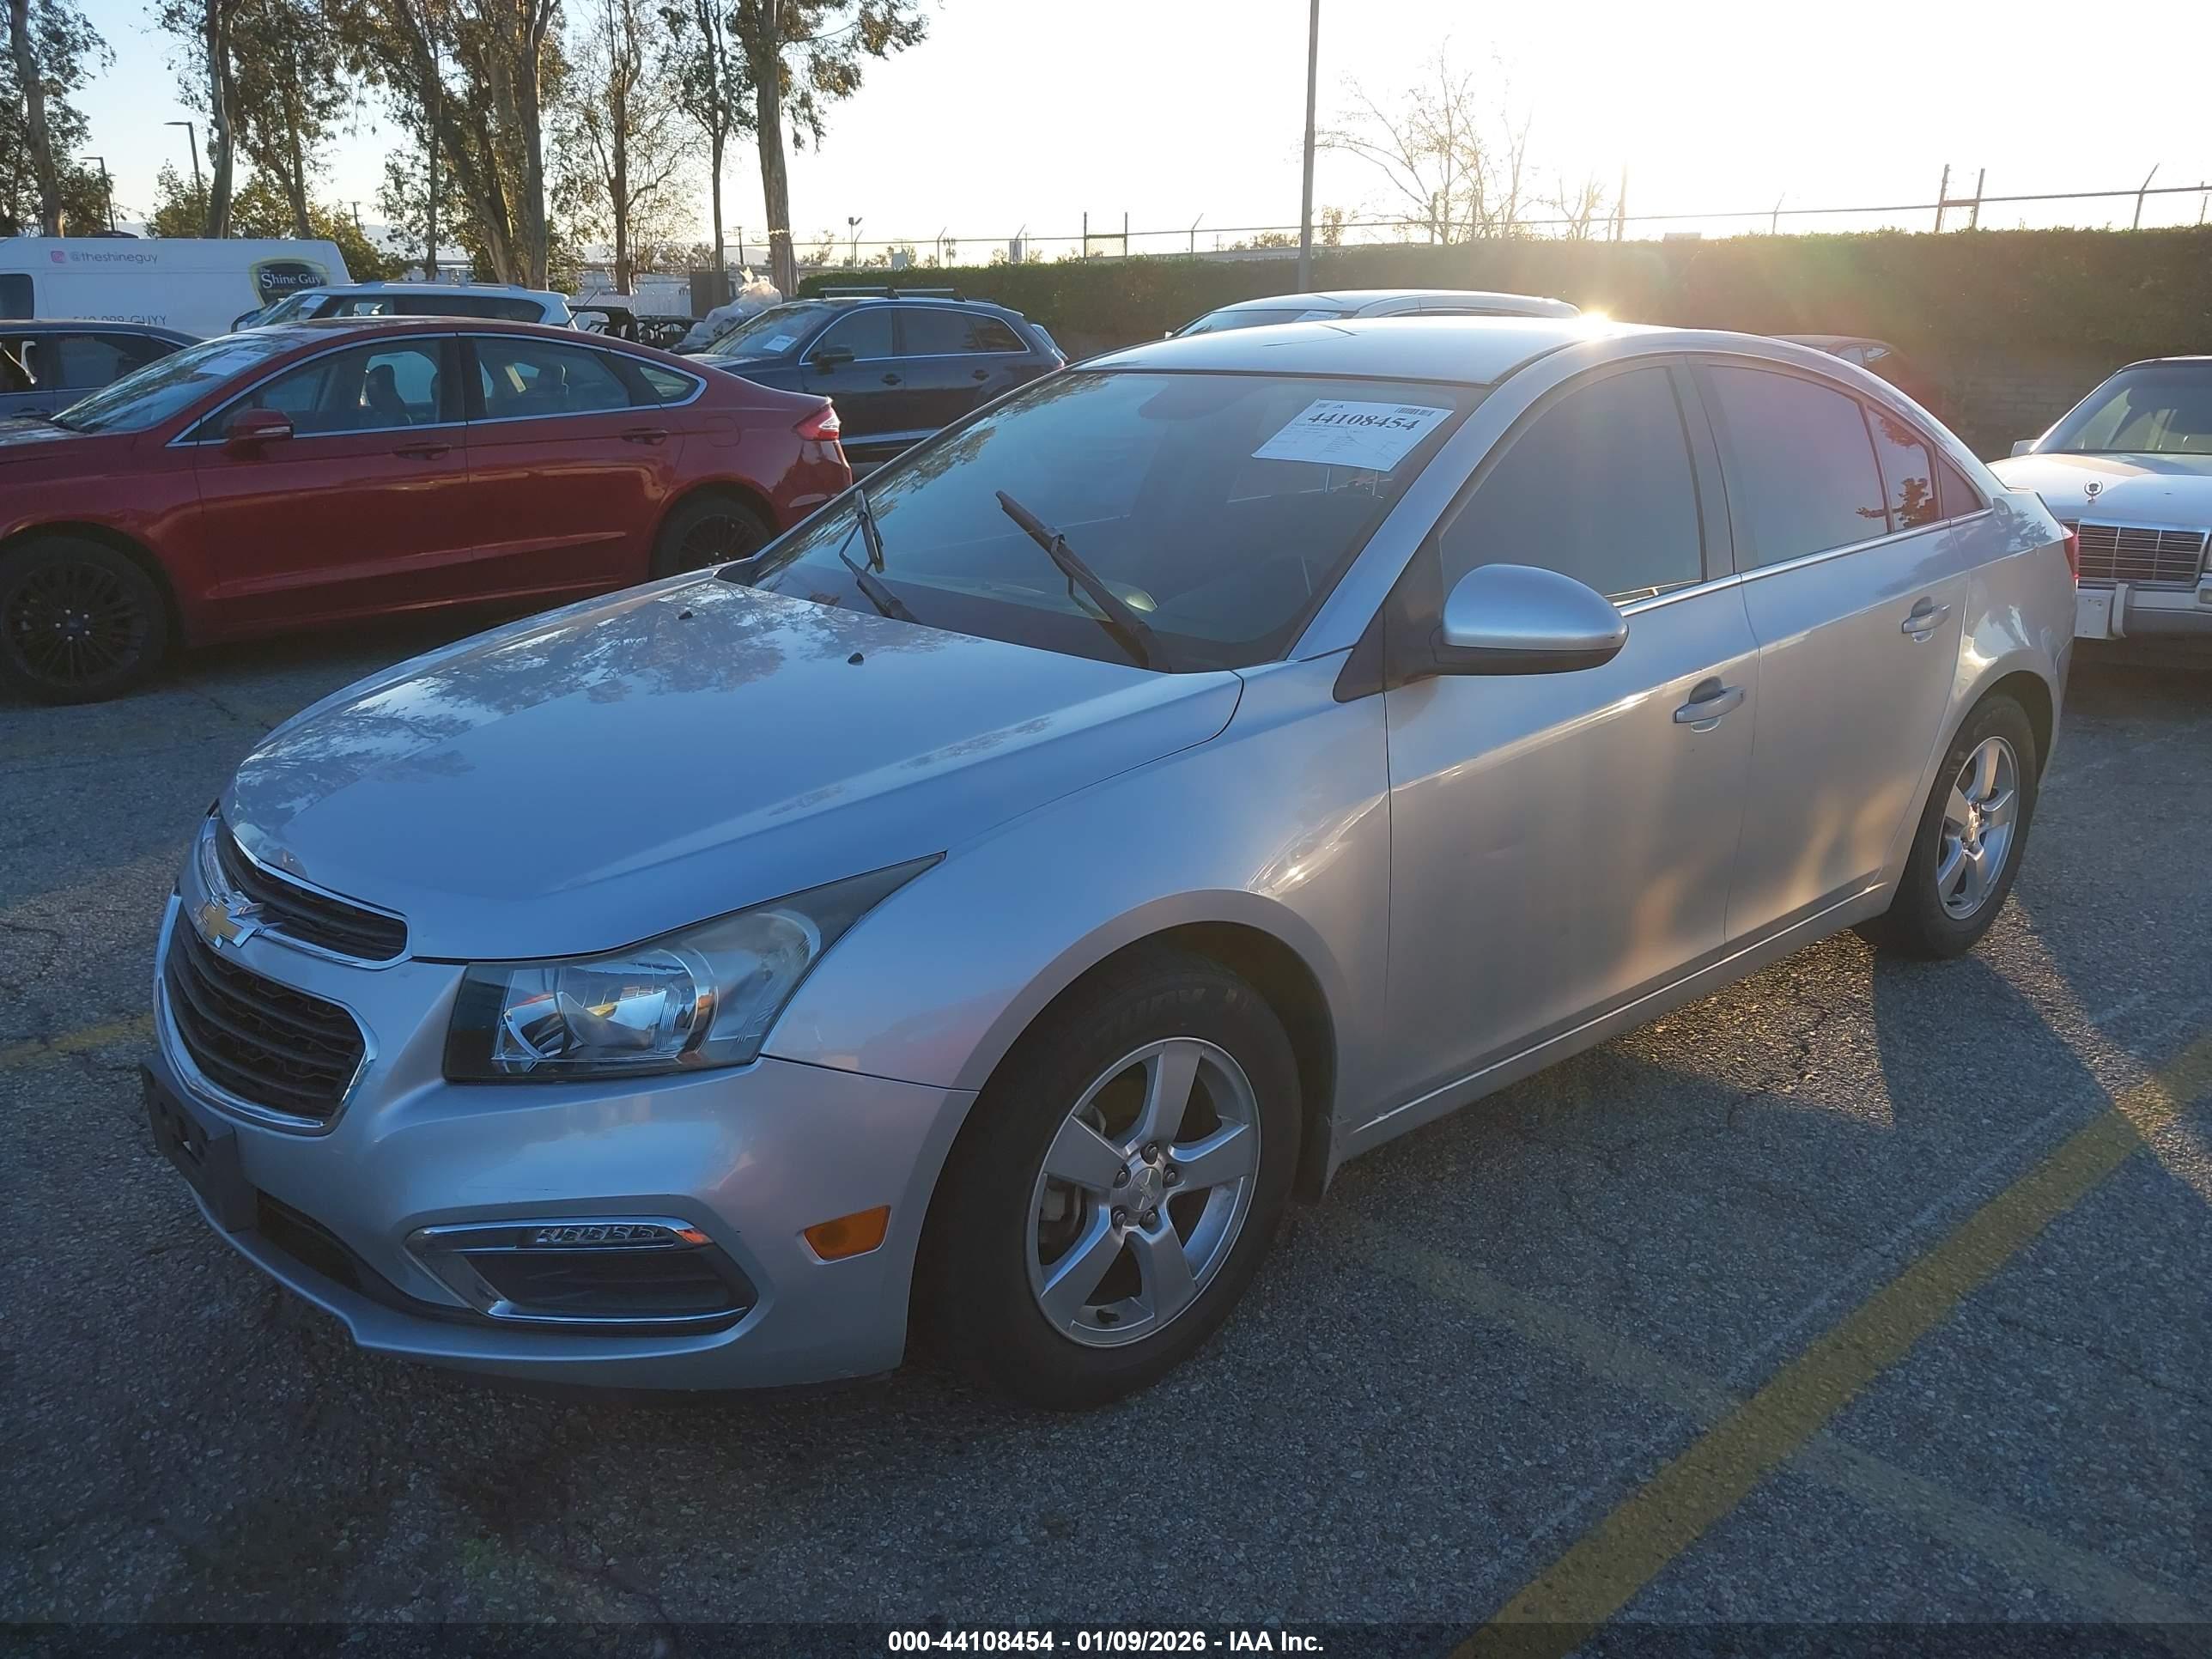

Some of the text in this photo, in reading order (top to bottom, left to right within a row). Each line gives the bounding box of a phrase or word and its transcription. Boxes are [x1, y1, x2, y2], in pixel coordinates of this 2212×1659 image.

[70, 252, 158, 264] @theshineguy
[261, 273, 322, 289] Shine Guy
[1308, 412, 1419, 430] 44108454
